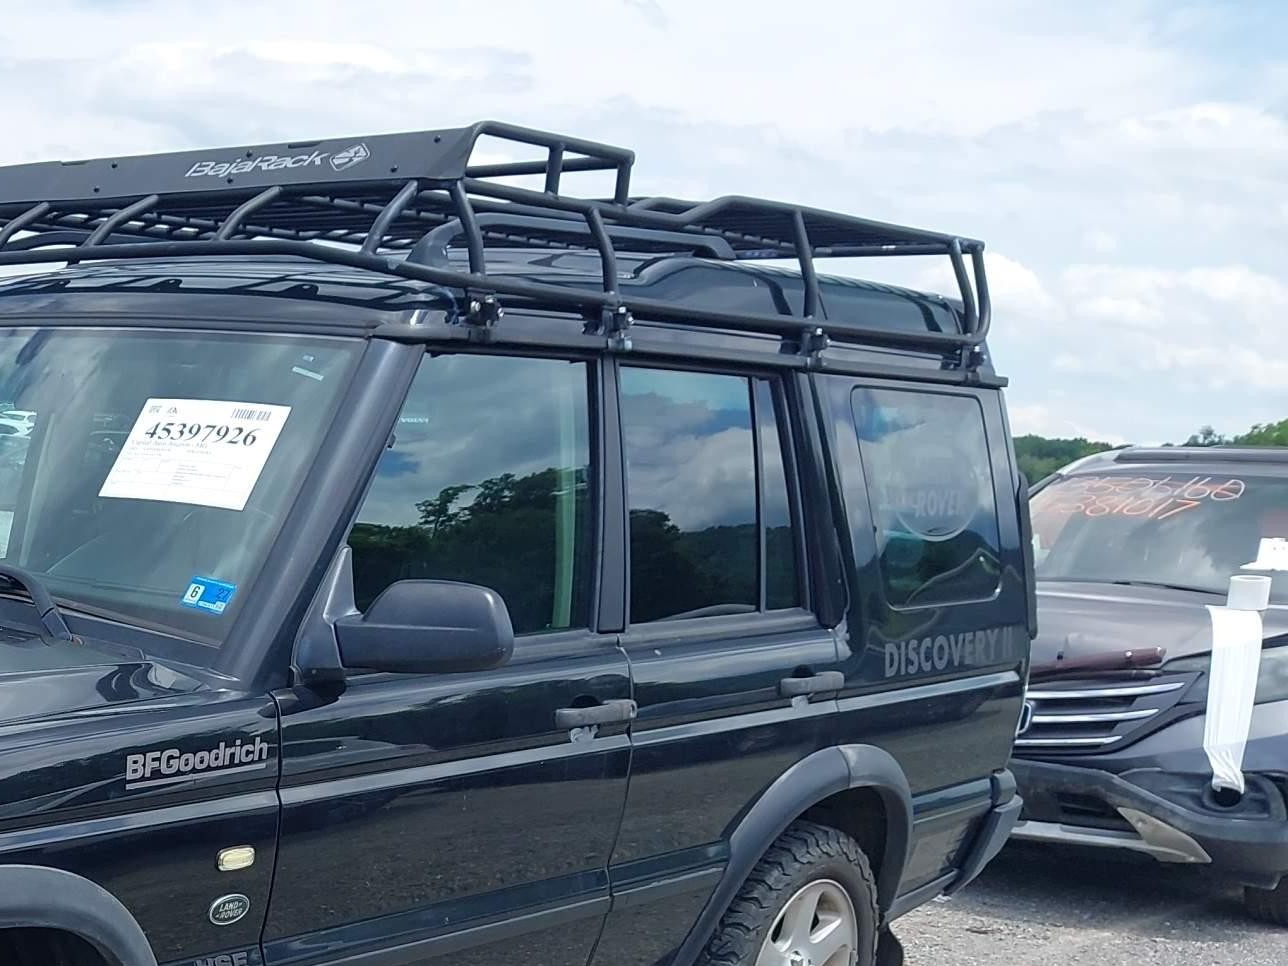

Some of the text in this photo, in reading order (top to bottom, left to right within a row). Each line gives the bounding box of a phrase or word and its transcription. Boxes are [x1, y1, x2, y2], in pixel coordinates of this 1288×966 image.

[184, 151, 329, 178] BajaRack
[144, 421, 262, 447] 45397926
[190, 585, 201, 598] 6
[884, 629, 999, 678] DISCOVERY
[126, 737, 268, 781] BFGoodrich
